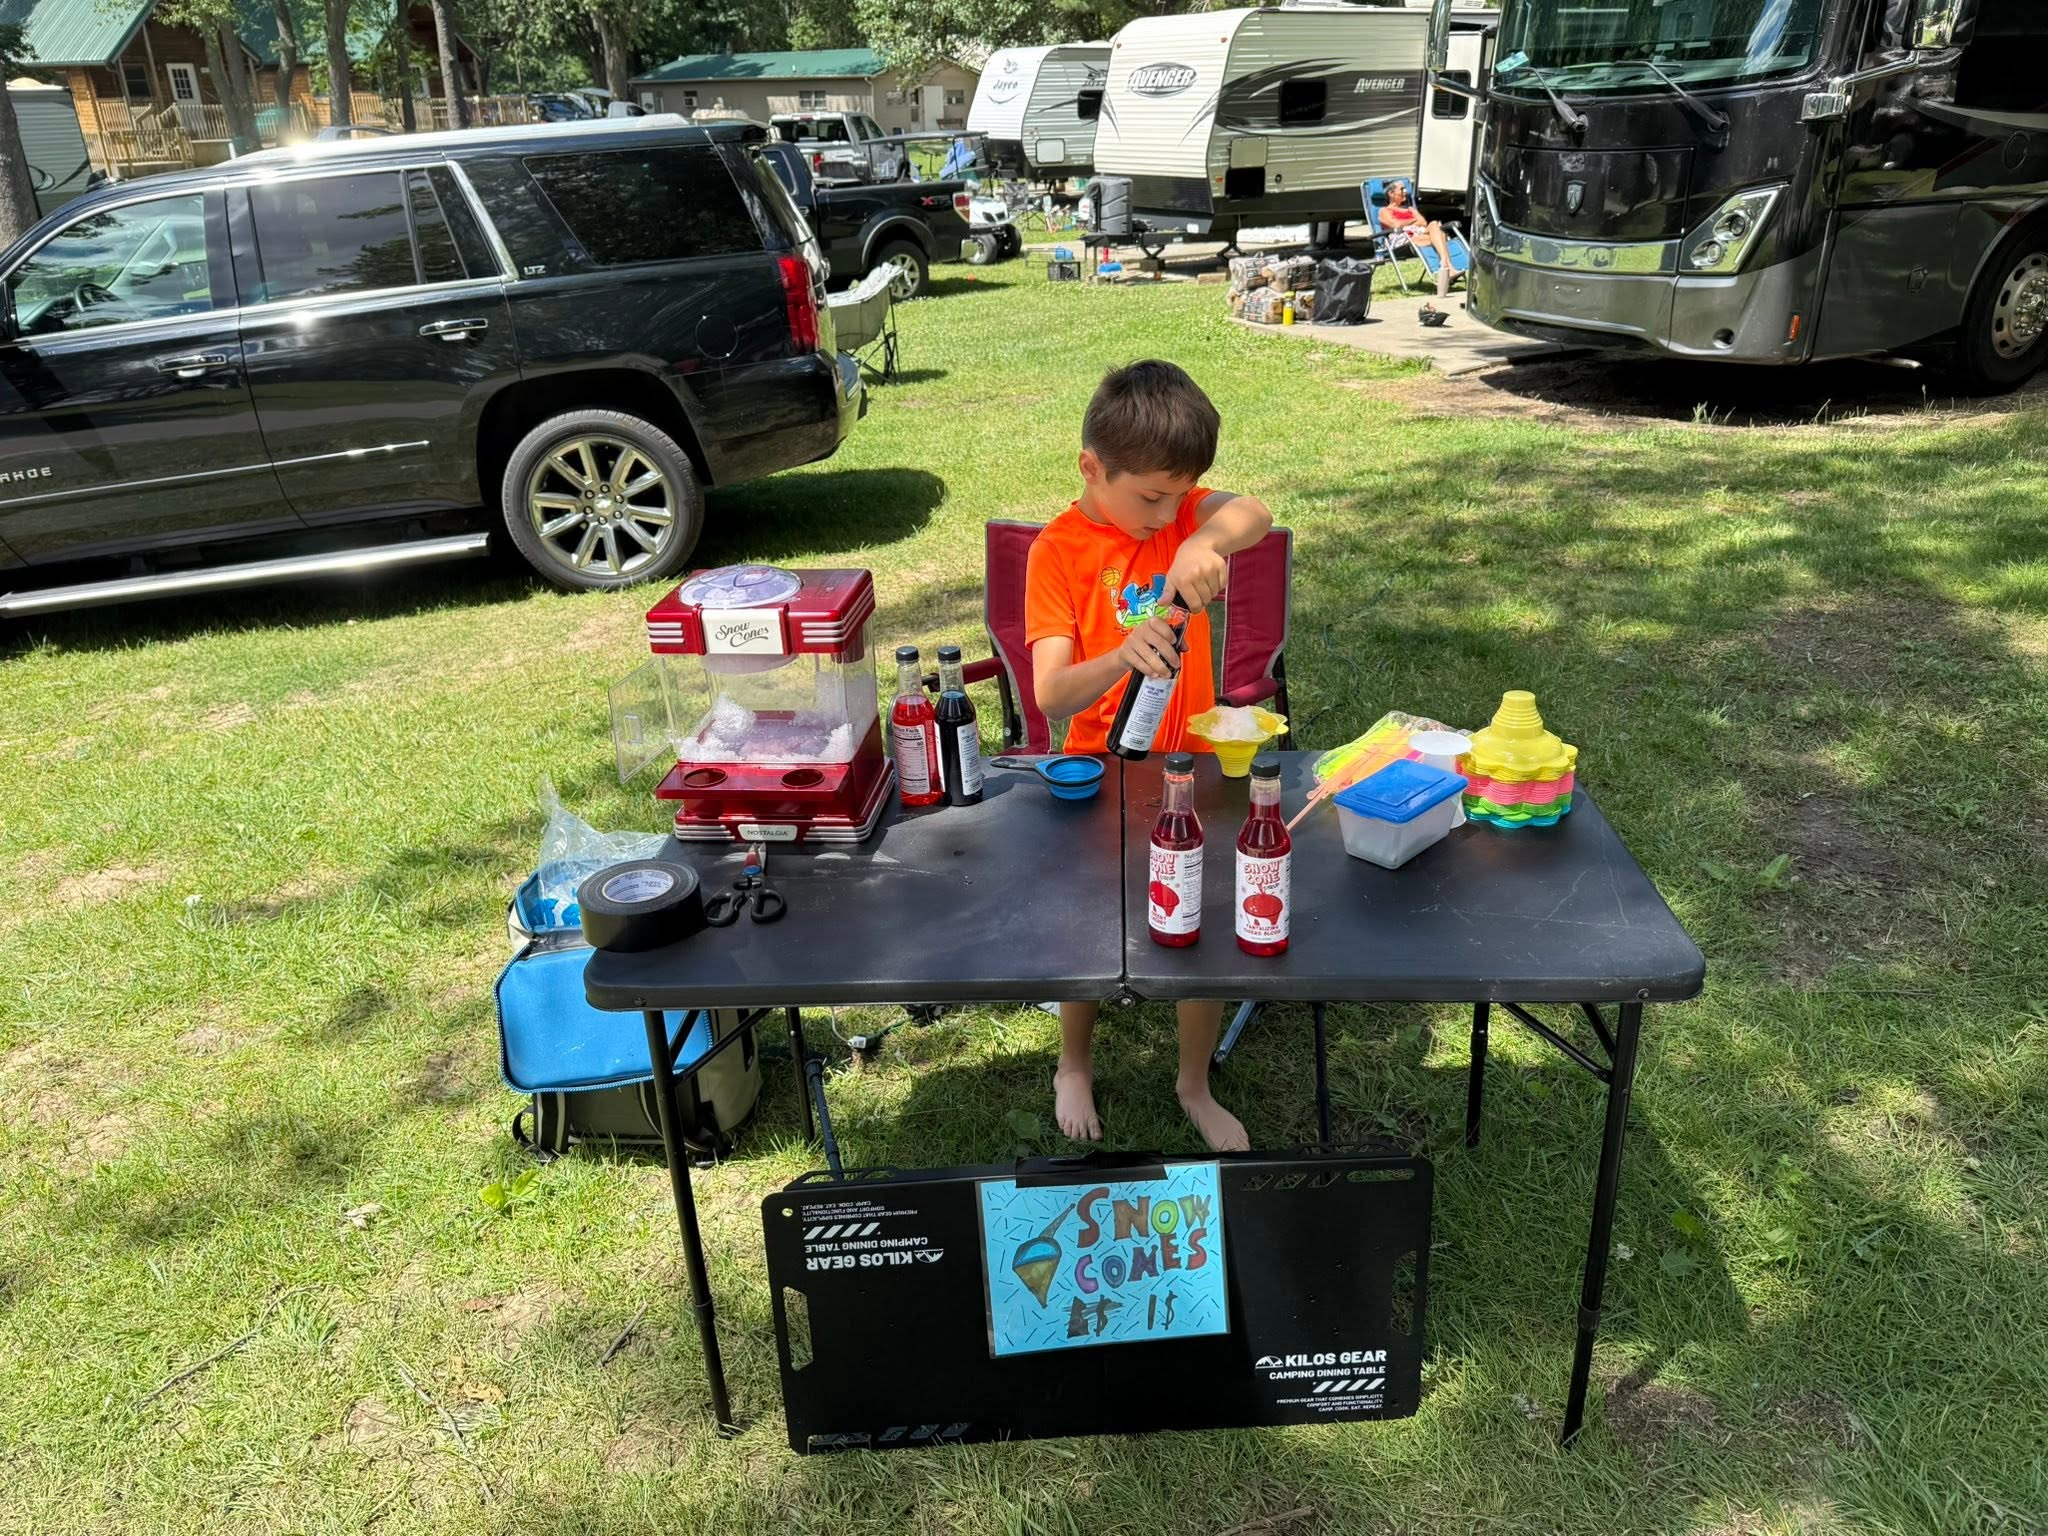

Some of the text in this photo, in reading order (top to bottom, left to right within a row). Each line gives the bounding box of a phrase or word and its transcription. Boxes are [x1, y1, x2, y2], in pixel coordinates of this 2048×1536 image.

[1129, 69, 1194, 87] AVENGER
[1353, 78, 1405, 93] AVENGER
[524, 265, 546, 275] LTZ
[715, 621, 751, 640] Snow
[730, 626, 769, 647] Cones
[1243, 860, 1280, 874] SNOW
[1246, 871, 1280, 885] CONE
[1077, 1187, 1211, 1248] SNOW
[805, 1237, 928, 1253] CAMPING DINING TABLE
[806, 1251, 913, 1271] KILOS GEAR
[1074, 1228, 1208, 1294] CONES
[1285, 1350, 1387, 1367] KILOS GEAR
[1269, 1366, 1386, 1380] CAMPING DINING TABLE
